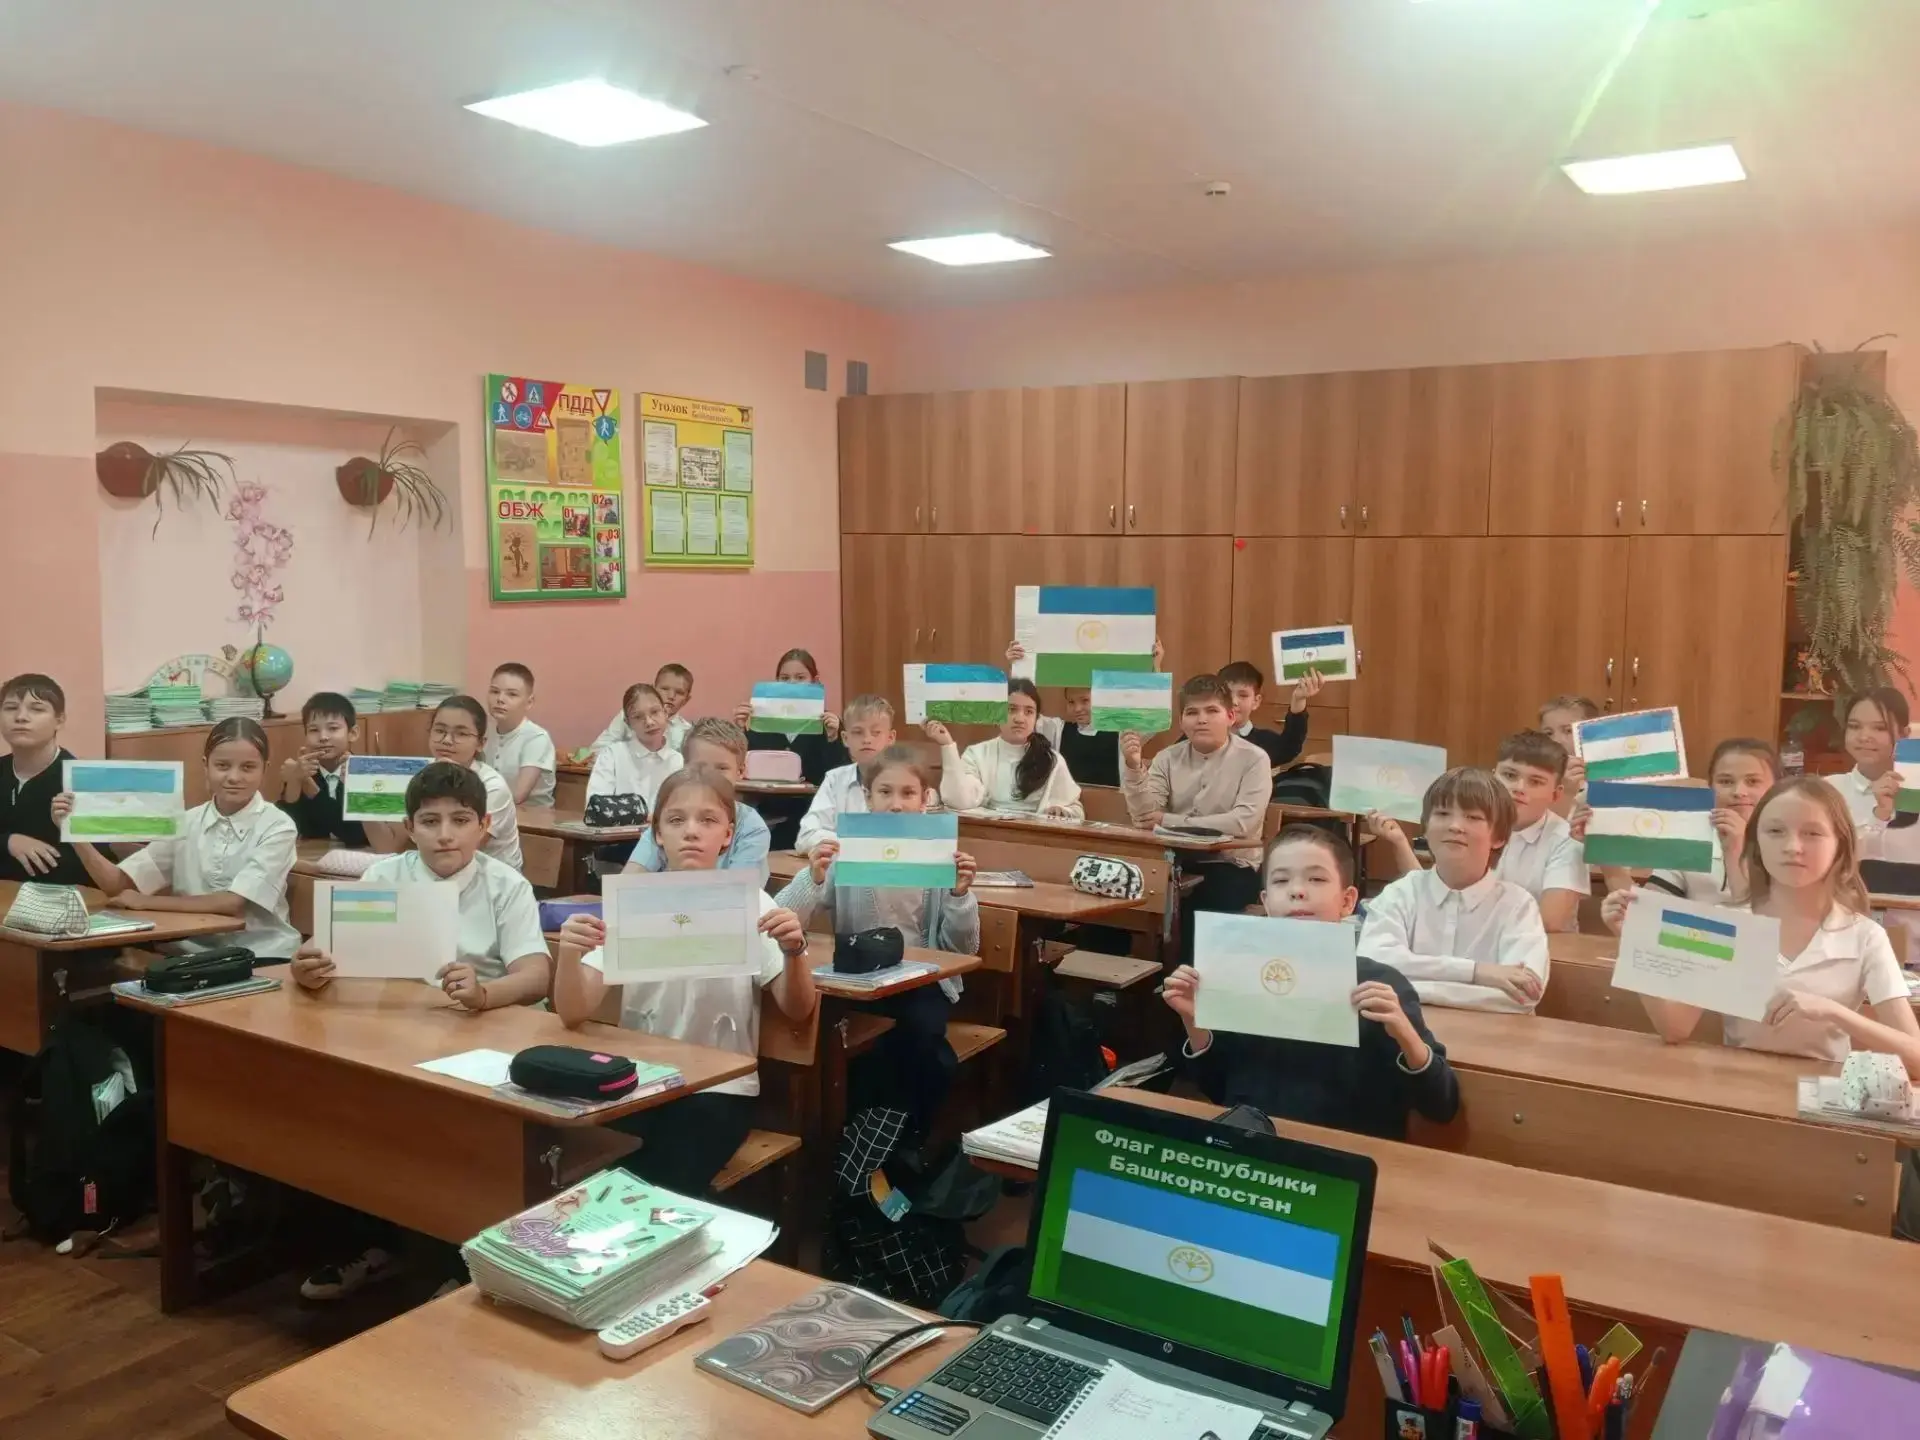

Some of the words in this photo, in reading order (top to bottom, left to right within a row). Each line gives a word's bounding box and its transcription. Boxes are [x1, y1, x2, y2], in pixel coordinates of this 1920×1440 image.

[559, 394, 595, 417] ПДД
[651, 398, 688, 415] Уголок
[593, 494, 605, 505] 02
[499, 500, 545, 519] ОБЖ
[564, 507, 575, 519] 01
[608, 529, 620, 540] 03
[609, 562, 620, 573] 04
[1094, 1129, 1155, 1155] Флаг
[1160, 1148, 1318, 1196] республики
[1109, 1155, 1293, 1215] Башкортостан
